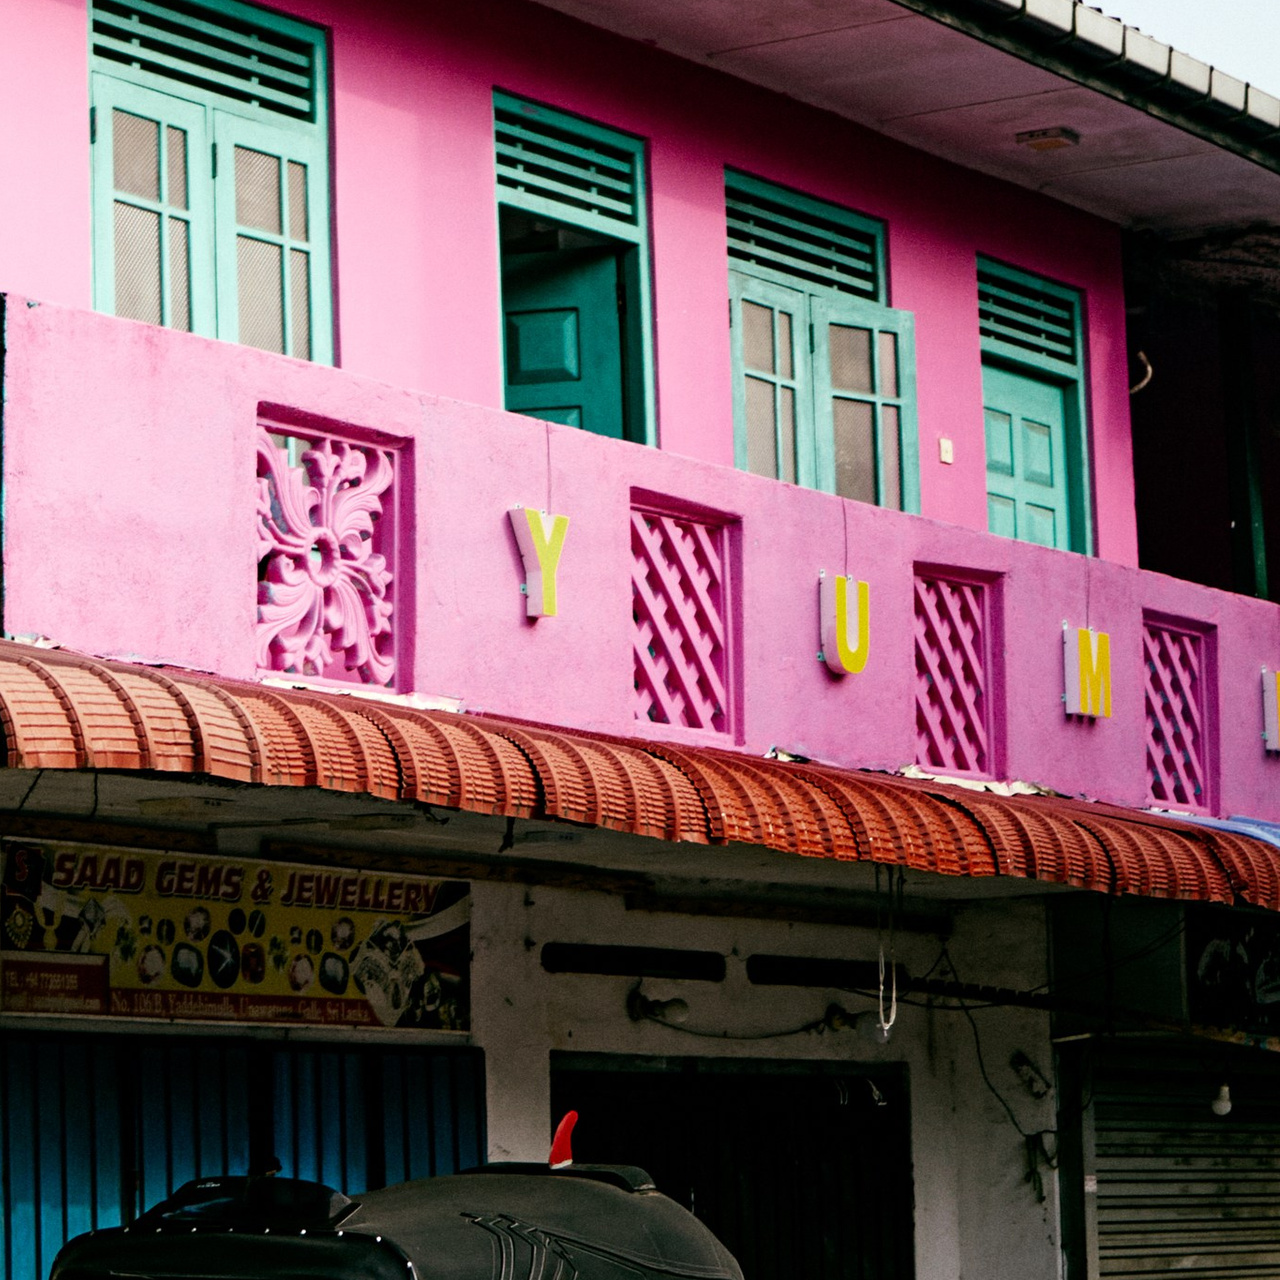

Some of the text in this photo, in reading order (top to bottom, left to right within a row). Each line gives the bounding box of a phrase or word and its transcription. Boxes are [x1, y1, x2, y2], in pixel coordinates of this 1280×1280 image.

[53, 852, 440, 915] SAAD GEMS & JEWELLERY
[111, 992, 129, 1013] No.
